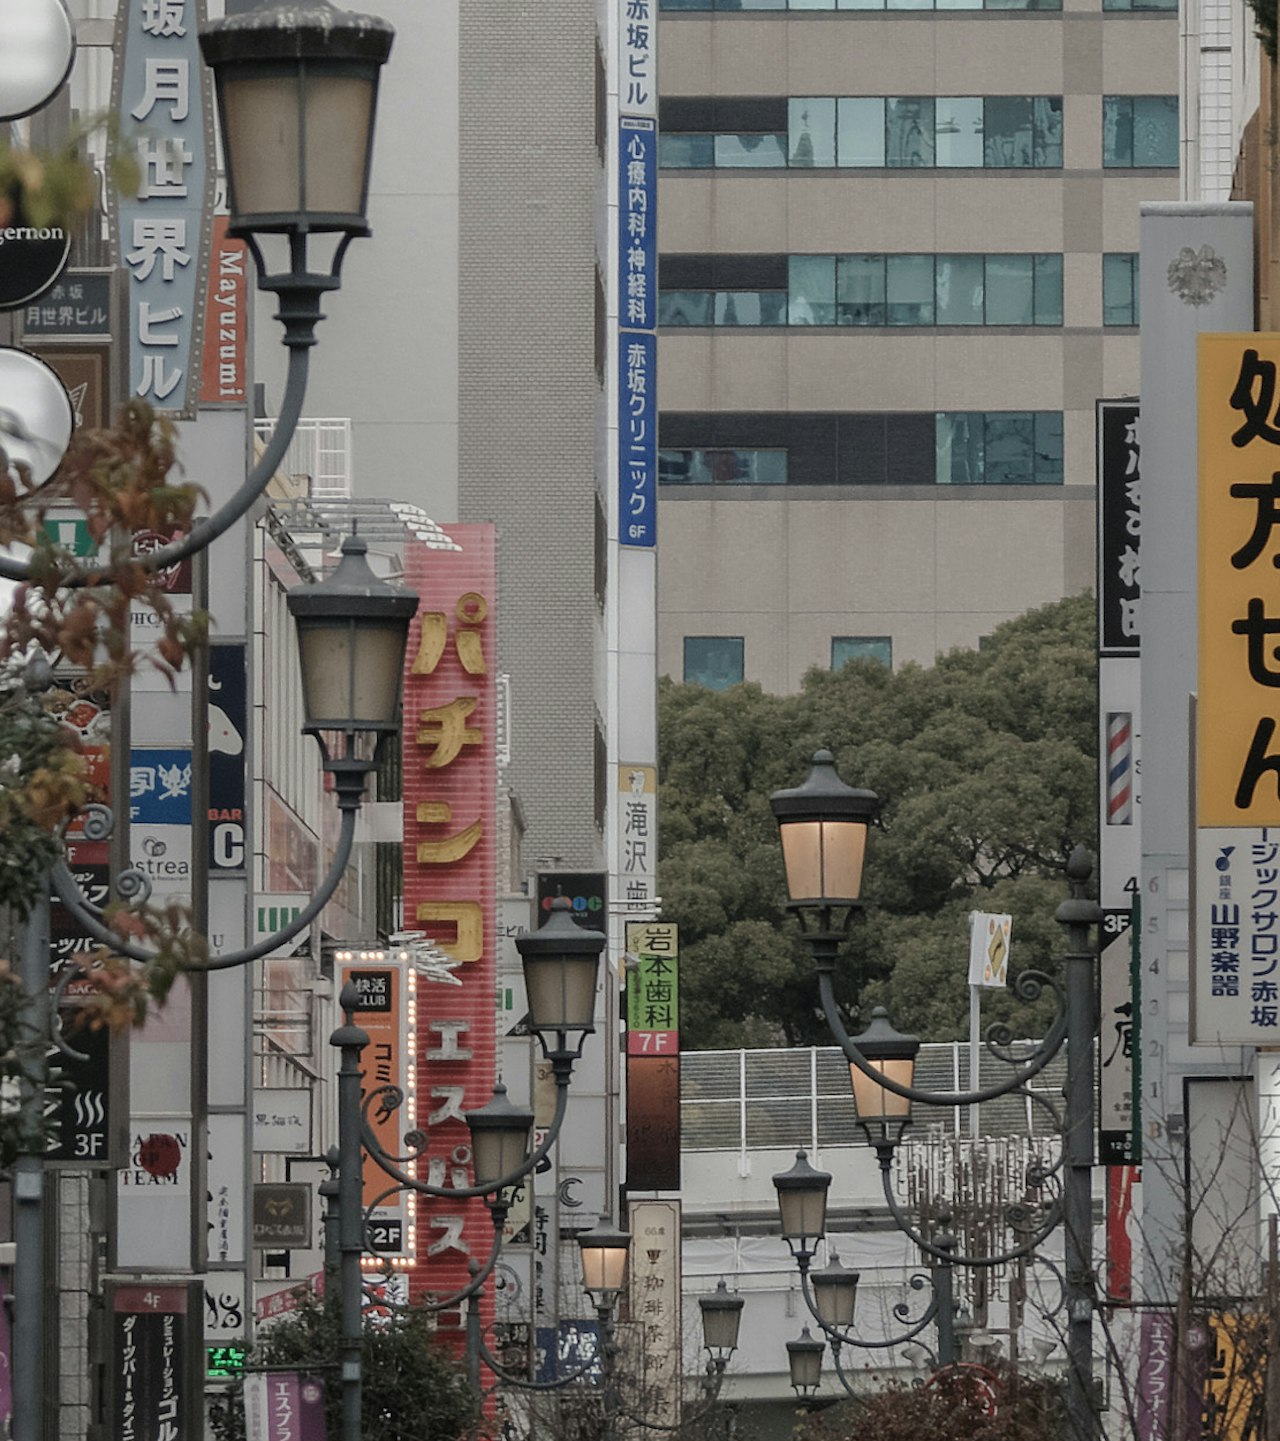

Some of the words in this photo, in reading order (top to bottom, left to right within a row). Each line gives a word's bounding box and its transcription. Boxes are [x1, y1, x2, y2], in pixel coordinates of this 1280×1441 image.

[627, 134, 647, 324] 心療内科・神経科
[51, 283, 84, 301] 赤坂
[26, 305, 107, 326] 月世界ビル
[215, 250, 244, 397] Mayuzumi
[627, 344, 647, 516] 赤坂クリニック
[628, 524, 647, 539] 6F
[411, 592, 488, 963] パチンコ
[209, 809, 243, 820] BAR
[1219, 875, 1232, 900] 銀座
[1103, 915, 1130, 934] 3F
[1211, 903, 1240, 997] 山野楽器
[645, 928, 674, 1029] 岩本歯科
[638, 1033, 667, 1052] 7F
[74, 1133, 104, 1156] 3F
[133, 1132, 187, 1149] APAN
[426, 1020, 473, 1256] エスパス
[120, 1170, 179, 1186] TEAM
[143, 1291, 161, 1309] 4F
